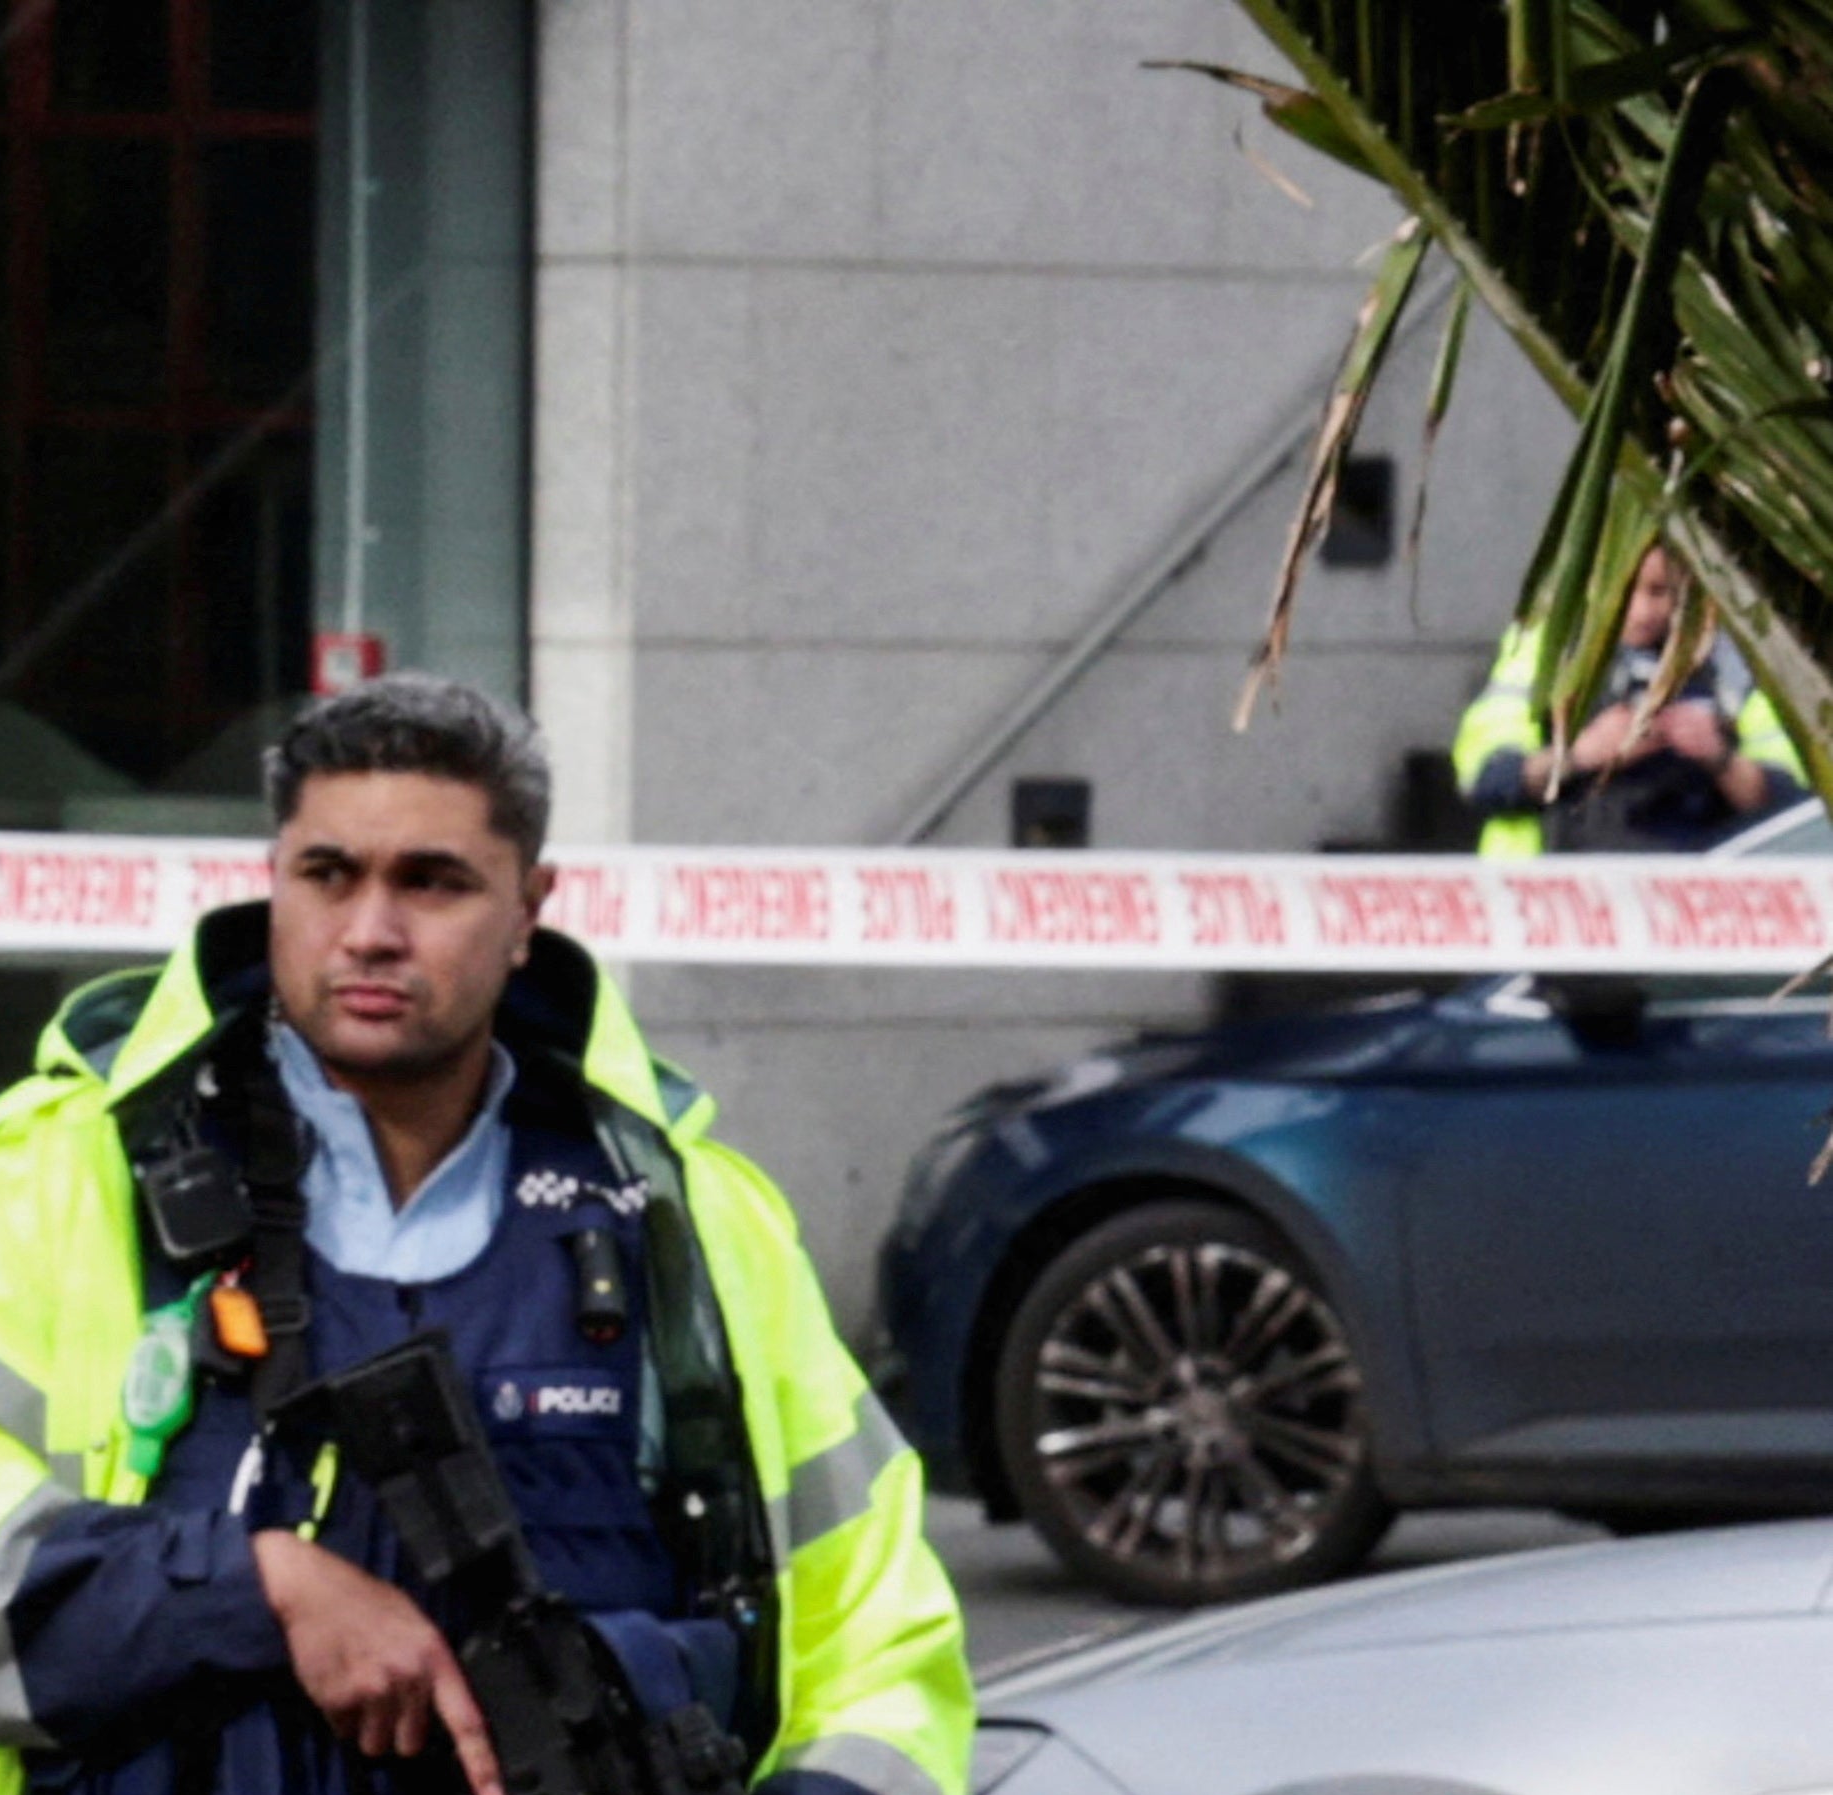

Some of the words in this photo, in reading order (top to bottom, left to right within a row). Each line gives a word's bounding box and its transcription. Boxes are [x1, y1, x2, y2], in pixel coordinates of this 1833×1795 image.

[657, 865, 834, 939] EMERGENCY
[855, 868, 958, 940] POLICE
[987, 869, 1162, 943] EMERGENCY
[1177, 873, 1289, 945] POLICE
[1307, 875, 1494, 947] EMERGENCY
[1504, 876, 1621, 948] POLICE
[1636, 876, 1827, 949] EMERGENCY
